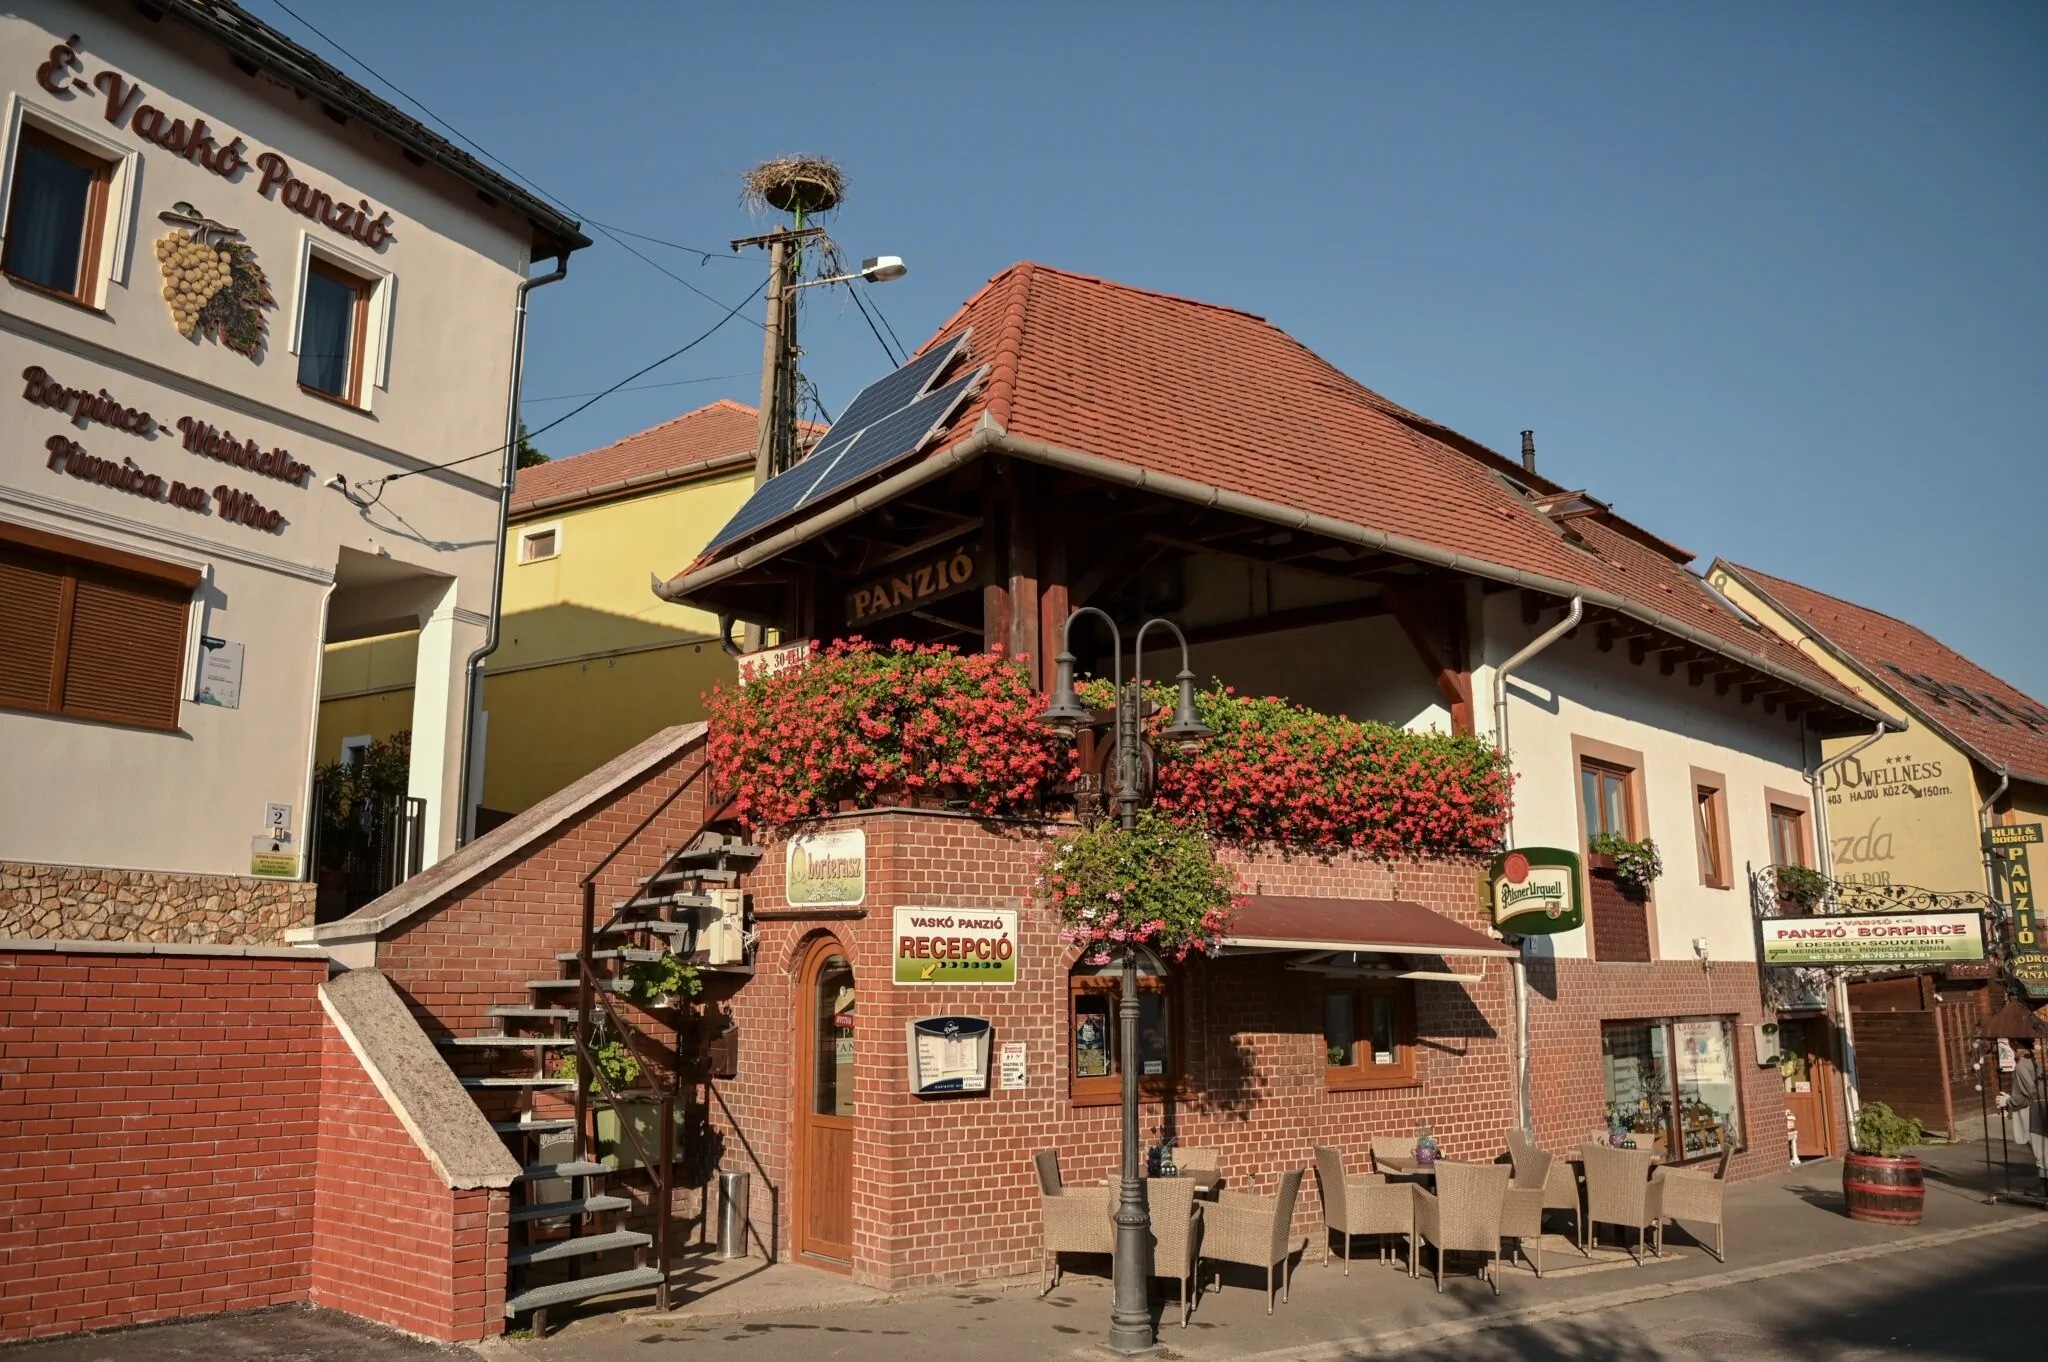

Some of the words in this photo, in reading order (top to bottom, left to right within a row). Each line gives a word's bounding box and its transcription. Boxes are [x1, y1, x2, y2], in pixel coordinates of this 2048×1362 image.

[256, 152, 393, 248] Panzió
[22, 366, 151, 434] Borpince
[176, 416, 311, 484] Weinkeller
[168, 480, 205, 510] na
[212, 485, 285, 533] Wino
[854, 546, 973, 619] PANZIÓ
[1862, 761, 1942, 786] WELLNESS
[1883, 785, 1900, 797] KÖZ
[274, 811, 283, 825] 2
[1992, 828, 2022, 838] HULI
[1502, 883, 1530, 908] Pilsner
[1528, 881, 1561, 900] Urquell
[2008, 847, 2035, 944] PANZIÓ
[911, 916, 954, 928] VASKÓ
[958, 917, 1003, 930] PANZIÓ
[1777, 926, 1846, 939] PANZIÓ
[1857, 924, 1966, 937] BORPINCE
[900, 932, 1013, 960] RECEPCIÓ
